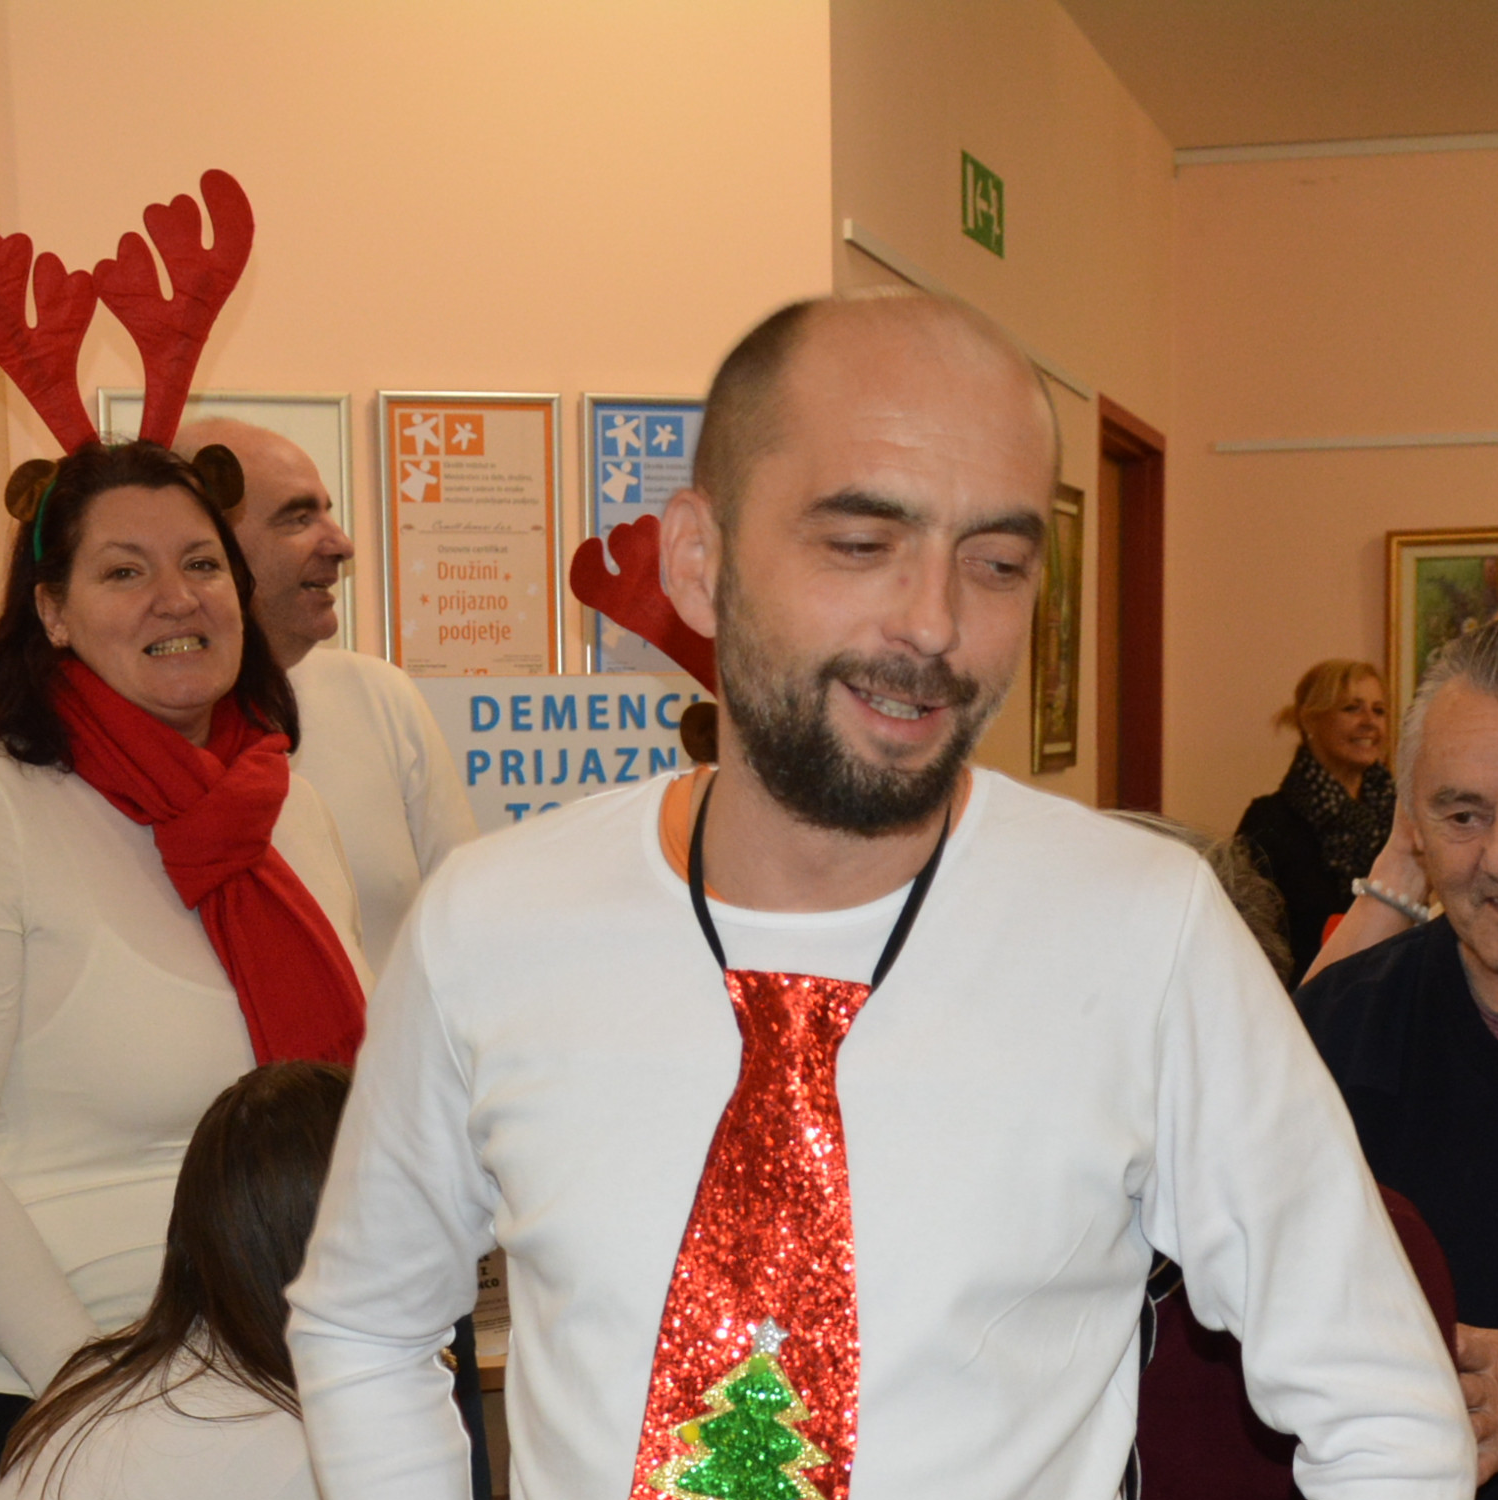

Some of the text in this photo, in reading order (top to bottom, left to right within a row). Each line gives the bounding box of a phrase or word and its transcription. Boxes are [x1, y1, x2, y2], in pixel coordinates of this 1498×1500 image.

[437, 561, 499, 581] Družini
[438, 590, 509, 615] prijazno
[438, 621, 512, 646] podjetje
[470, 693, 699, 732] DEMENC
[467, 747, 678, 787] PRIJAZN
